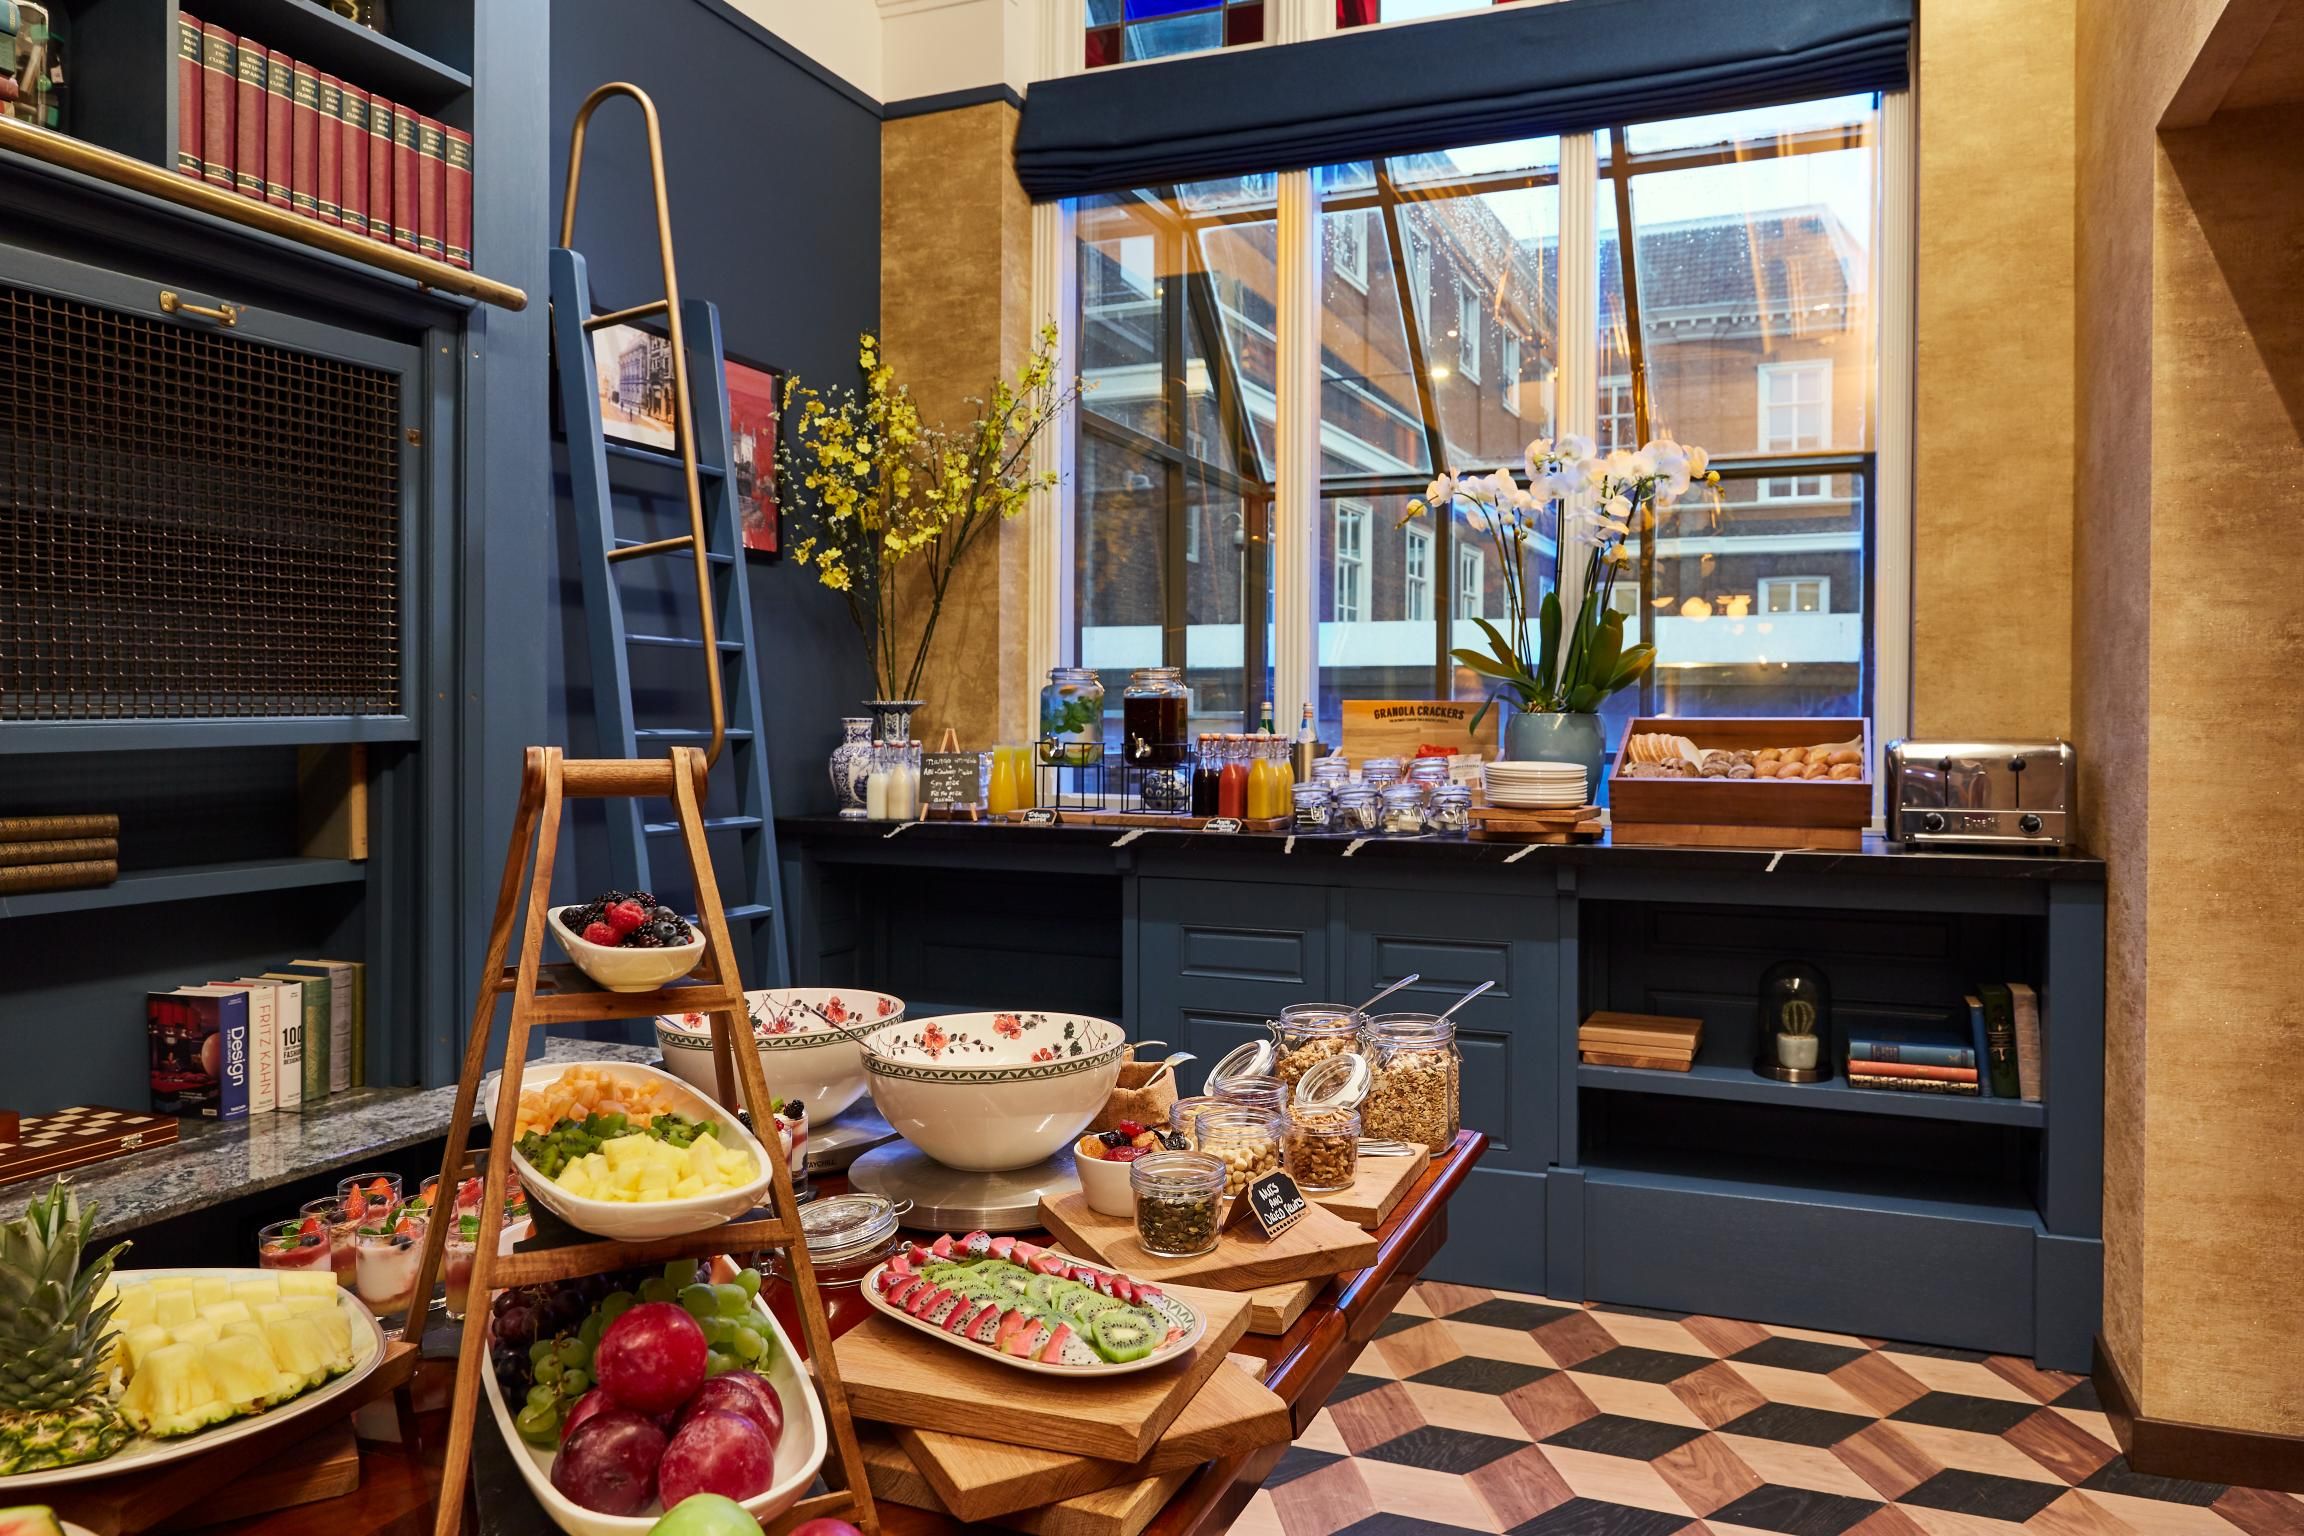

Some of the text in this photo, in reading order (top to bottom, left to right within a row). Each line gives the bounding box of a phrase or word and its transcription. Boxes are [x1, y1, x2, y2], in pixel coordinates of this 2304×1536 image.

[1374, 706, 1415, 719] GRANOLA
[1417, 705, 1464, 720] CRACKERS
[259, 1004, 271, 1048] FRITZ
[227, 1026, 245, 1086] Design
[259, 1052, 272, 1095] KAHN
[1268, 1195, 1283, 1209] AND
